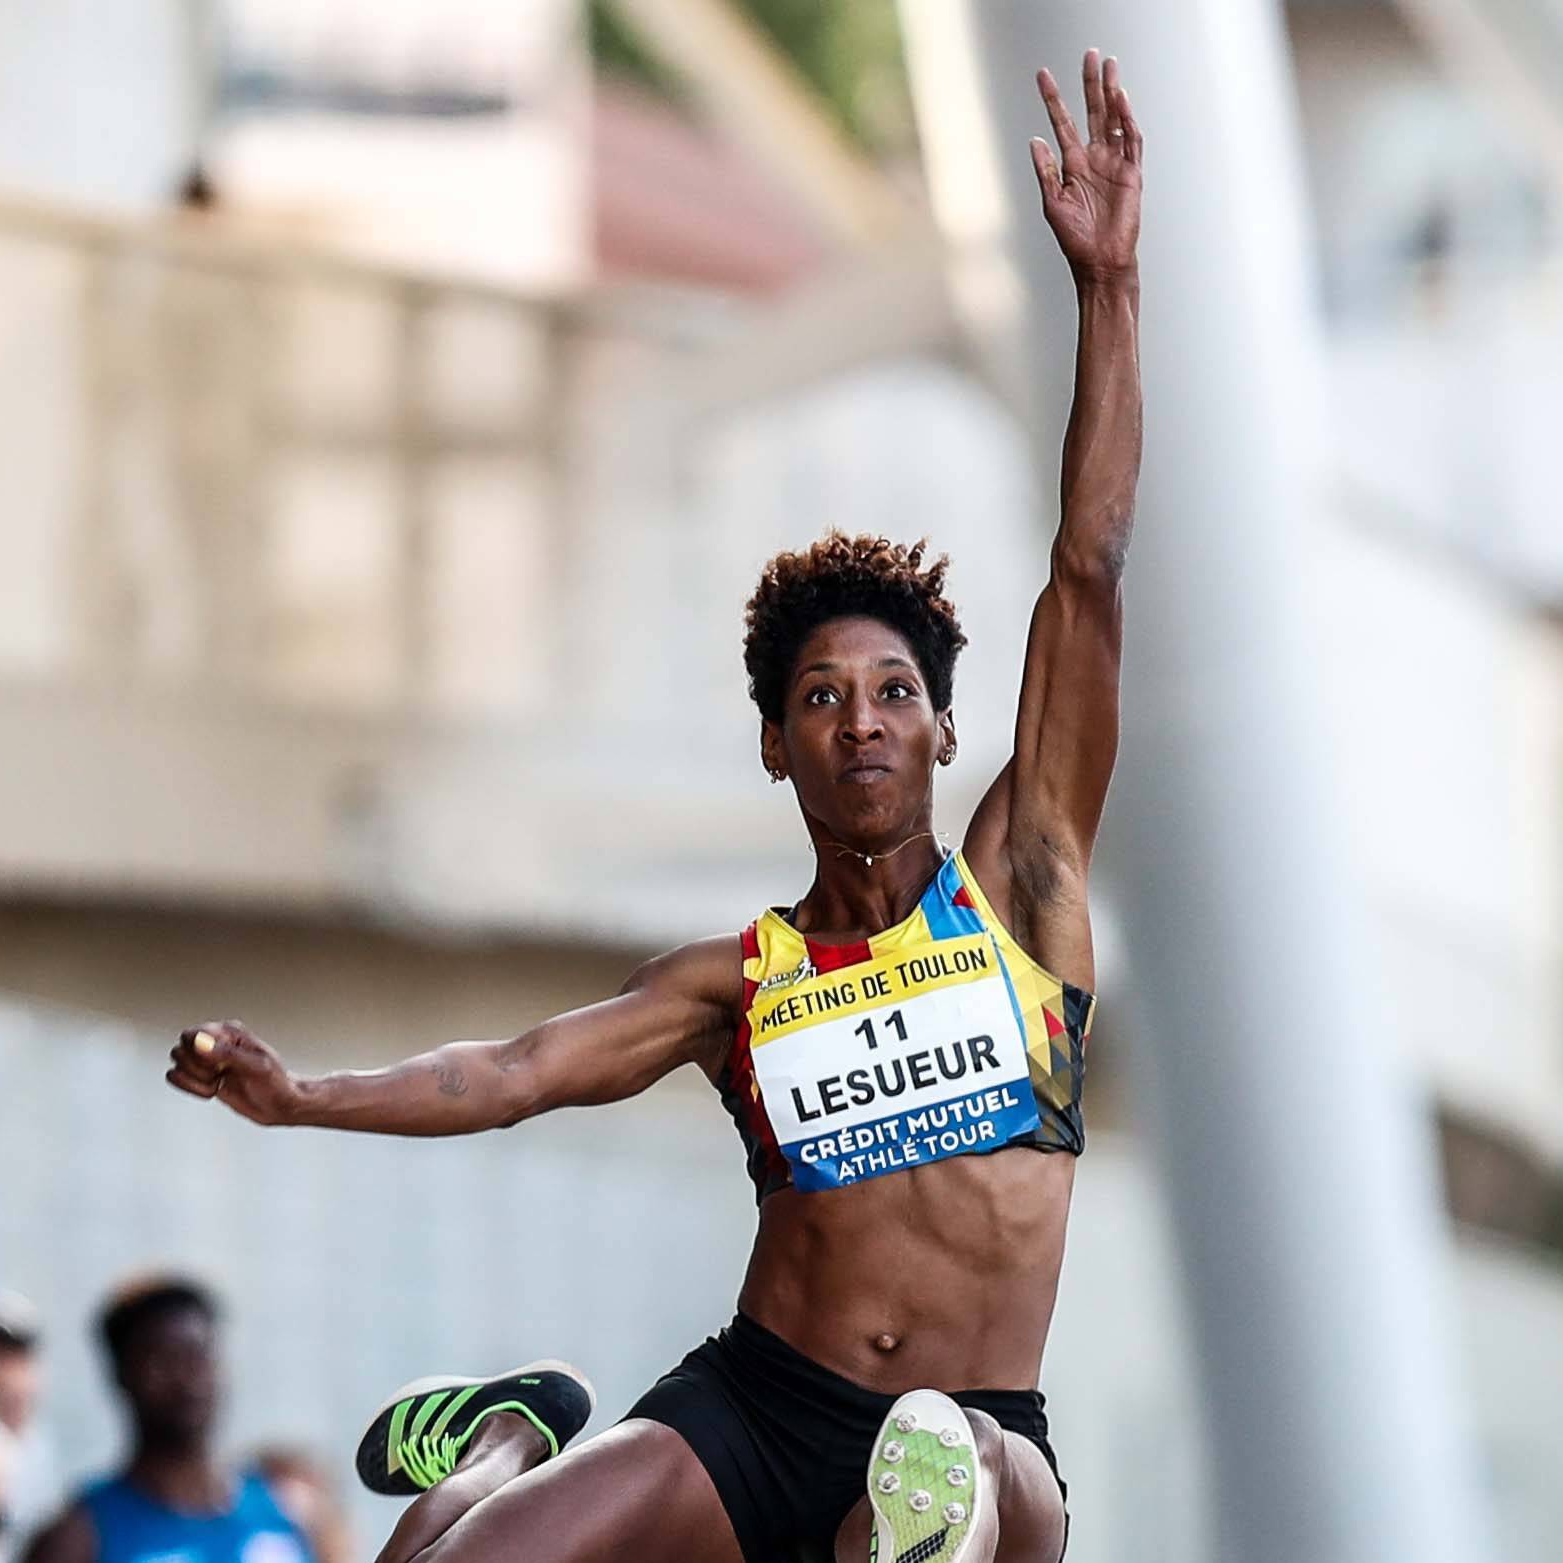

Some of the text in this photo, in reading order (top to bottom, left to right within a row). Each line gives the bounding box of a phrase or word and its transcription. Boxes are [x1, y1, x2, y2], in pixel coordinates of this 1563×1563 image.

[760, 982, 856, 1032] MEETING
[861, 971, 891, 1000] DE
[895, 948, 987, 988] TOULON
[854, 1010, 909, 1049] 11
[791, 1034, 1001, 1123] LESUEUR
[799, 1087, 1019, 1164] CRÉDIT MUTUEL
[838, 1123, 996, 1181] ATHLÉ TOUR
